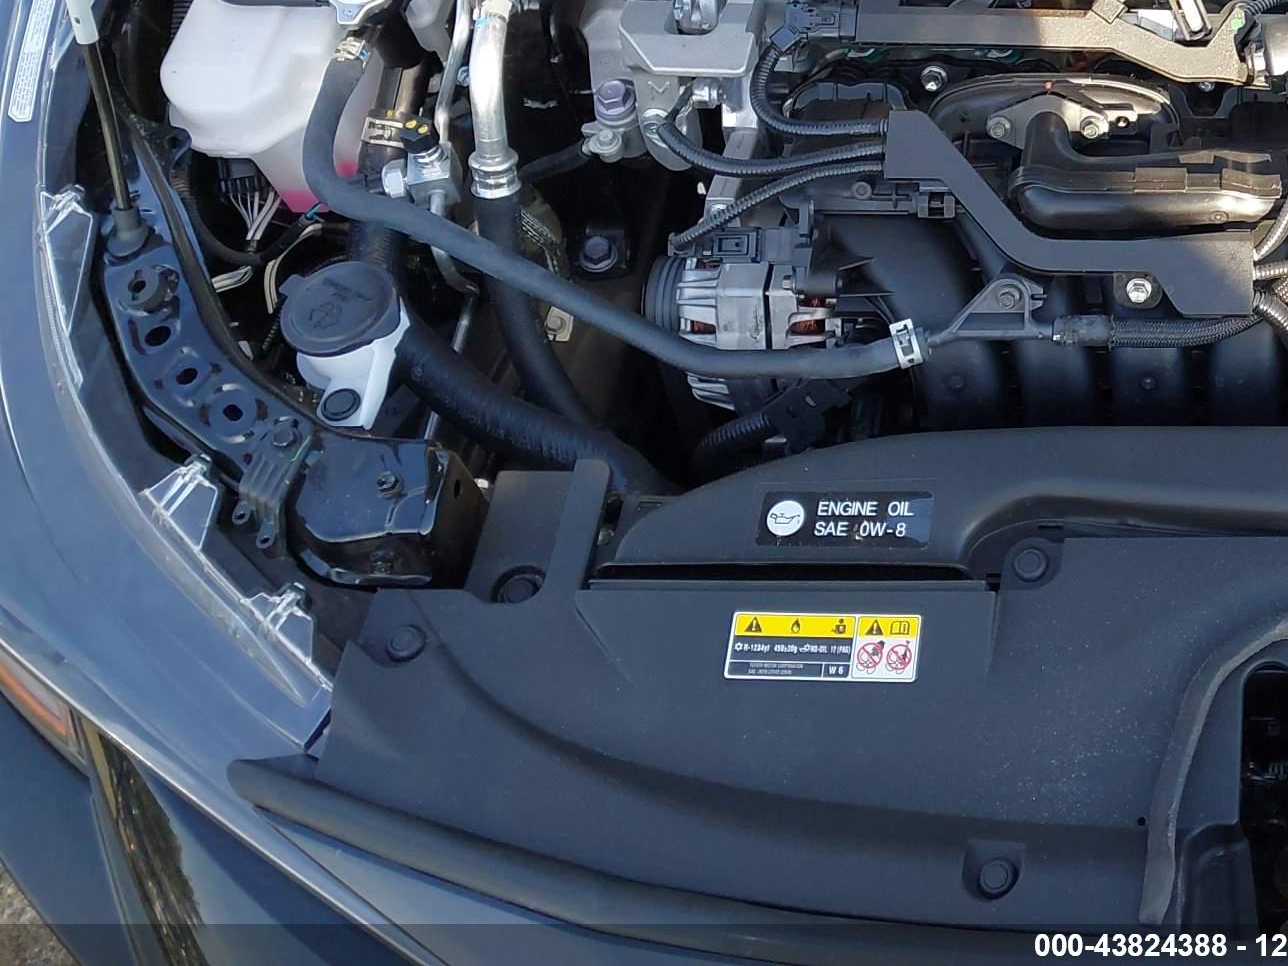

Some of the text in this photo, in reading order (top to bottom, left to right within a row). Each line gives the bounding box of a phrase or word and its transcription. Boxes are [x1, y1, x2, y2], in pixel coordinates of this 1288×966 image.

[817, 500, 915, 516] ENGINE OIL
[814, 521, 906, 538] SAE 0W-8
